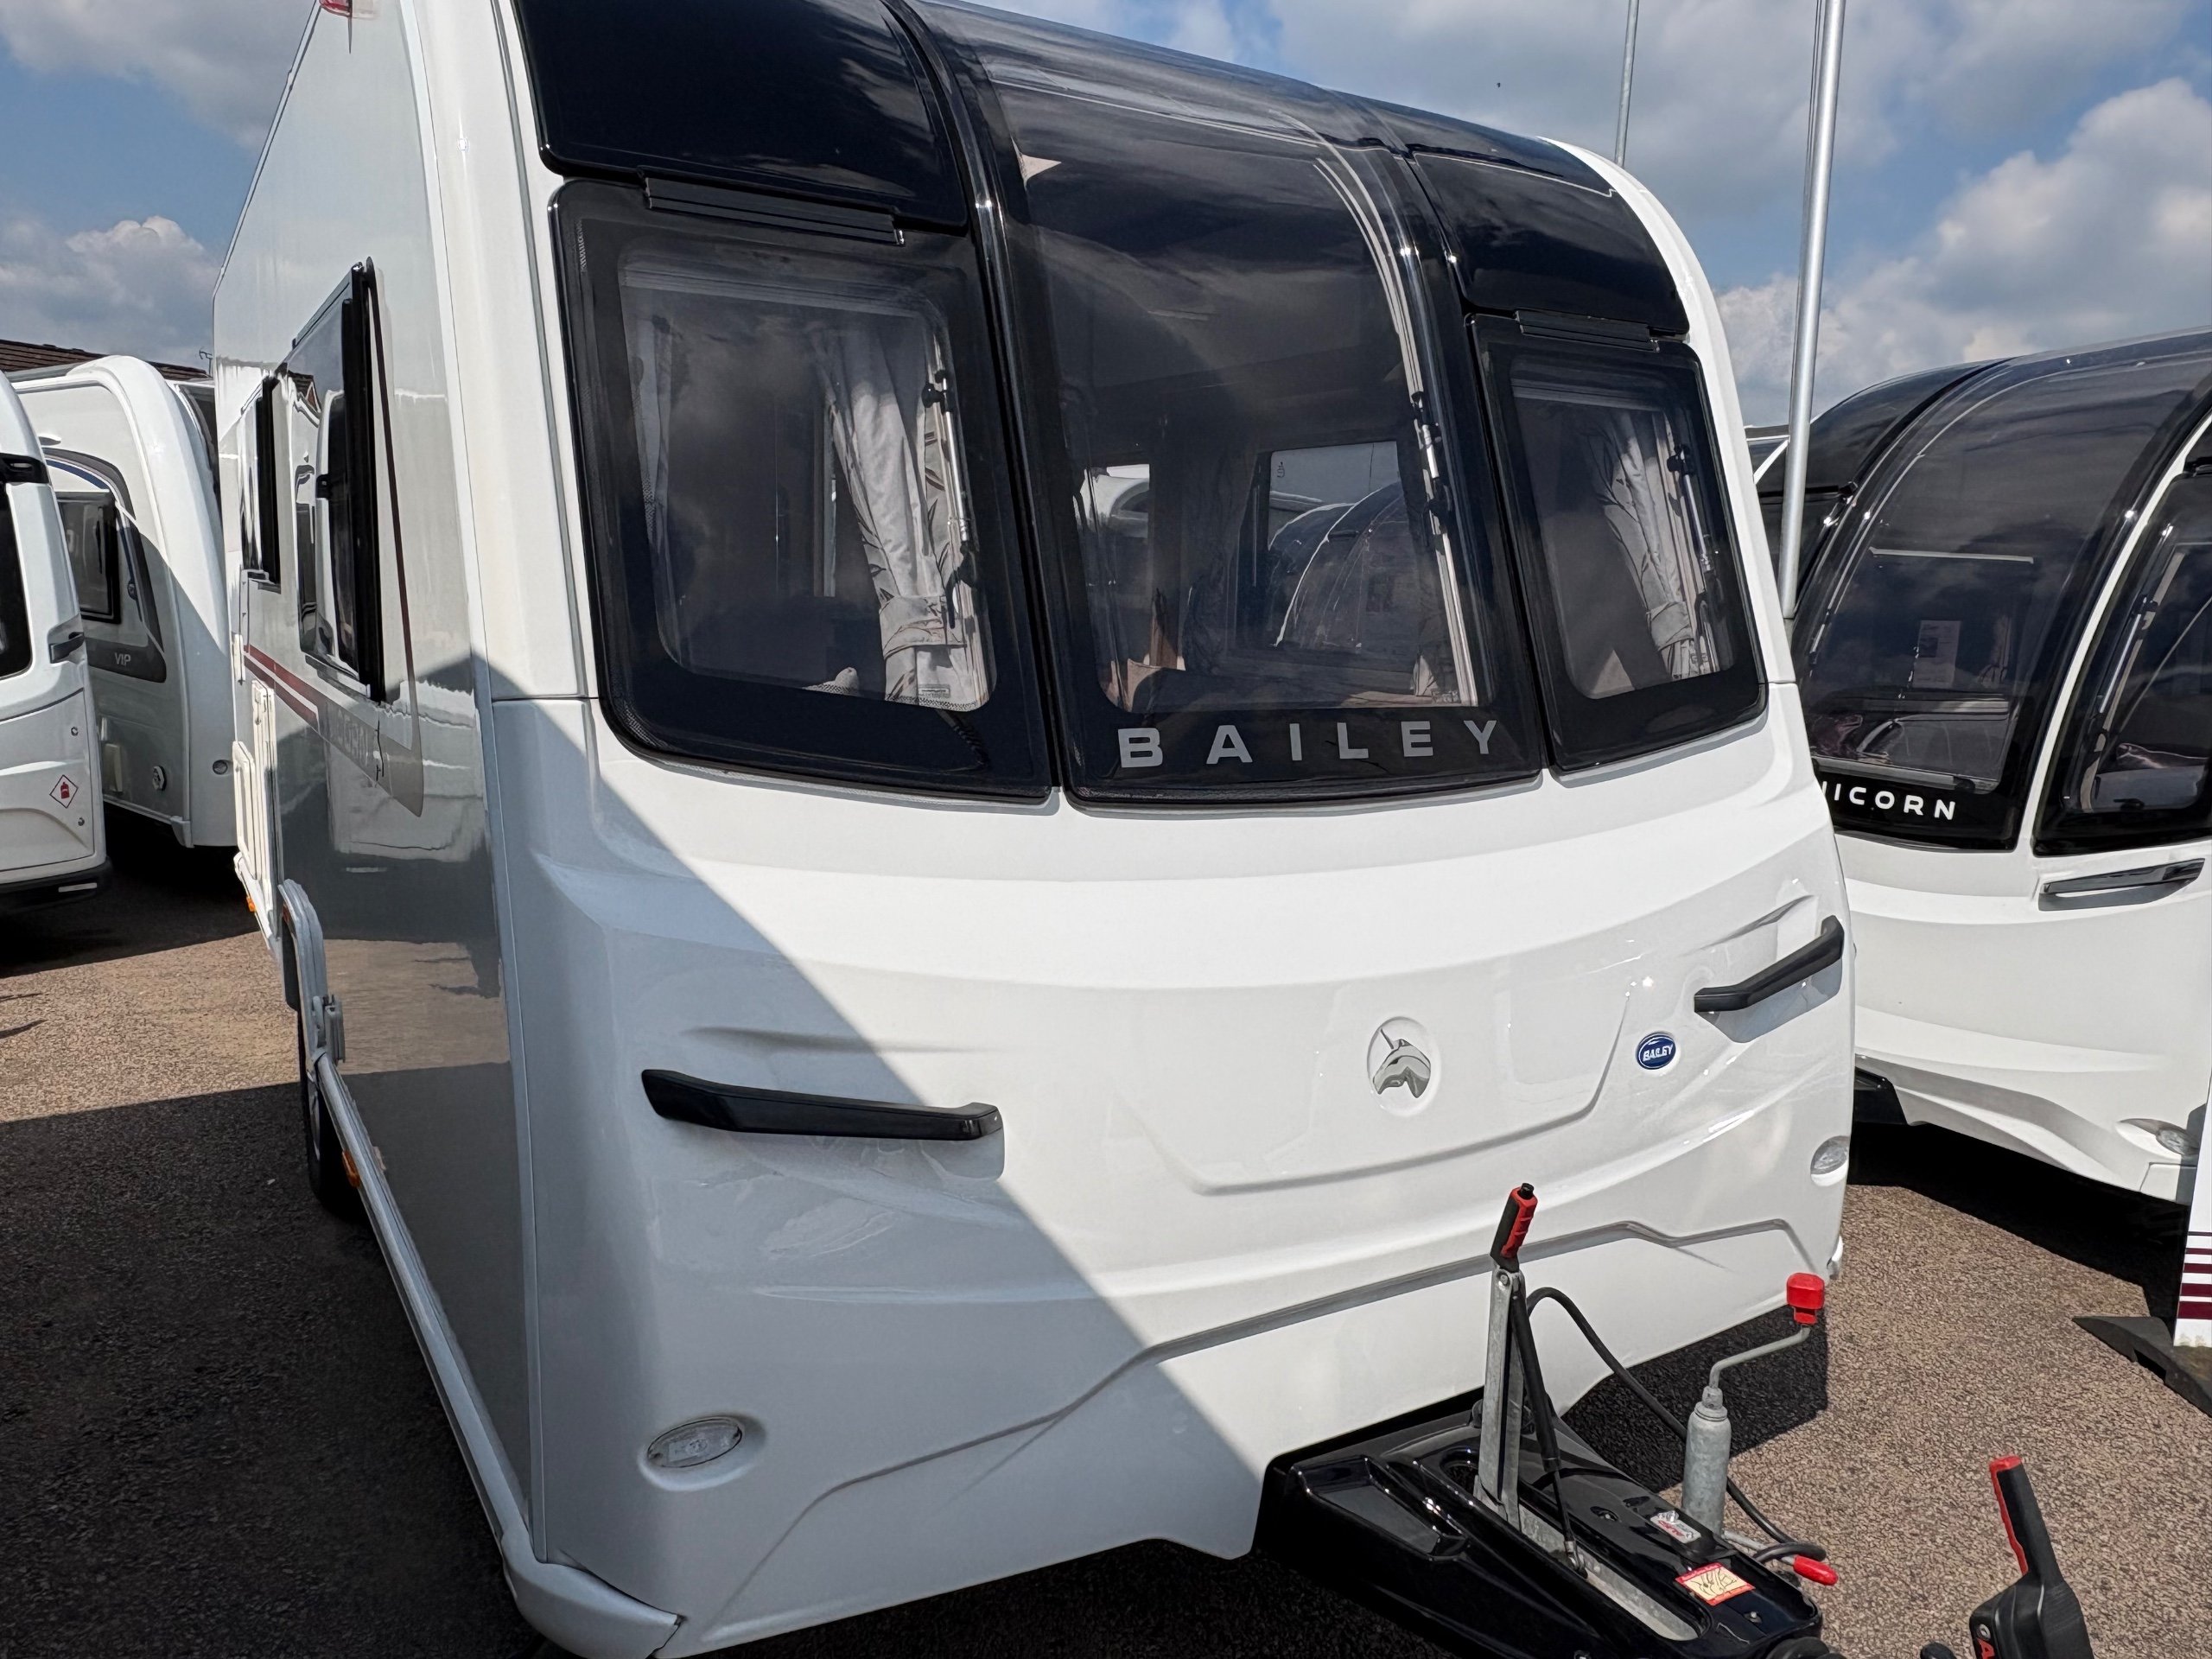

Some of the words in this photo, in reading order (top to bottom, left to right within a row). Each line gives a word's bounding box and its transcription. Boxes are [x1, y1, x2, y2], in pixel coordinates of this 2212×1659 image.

[114, 652, 131, 666] VIP
[1117, 720, 1497, 768] BAILEY
[1821, 780, 1956, 821] ICORN
[1643, 1043, 1674, 1062] BAILEY
